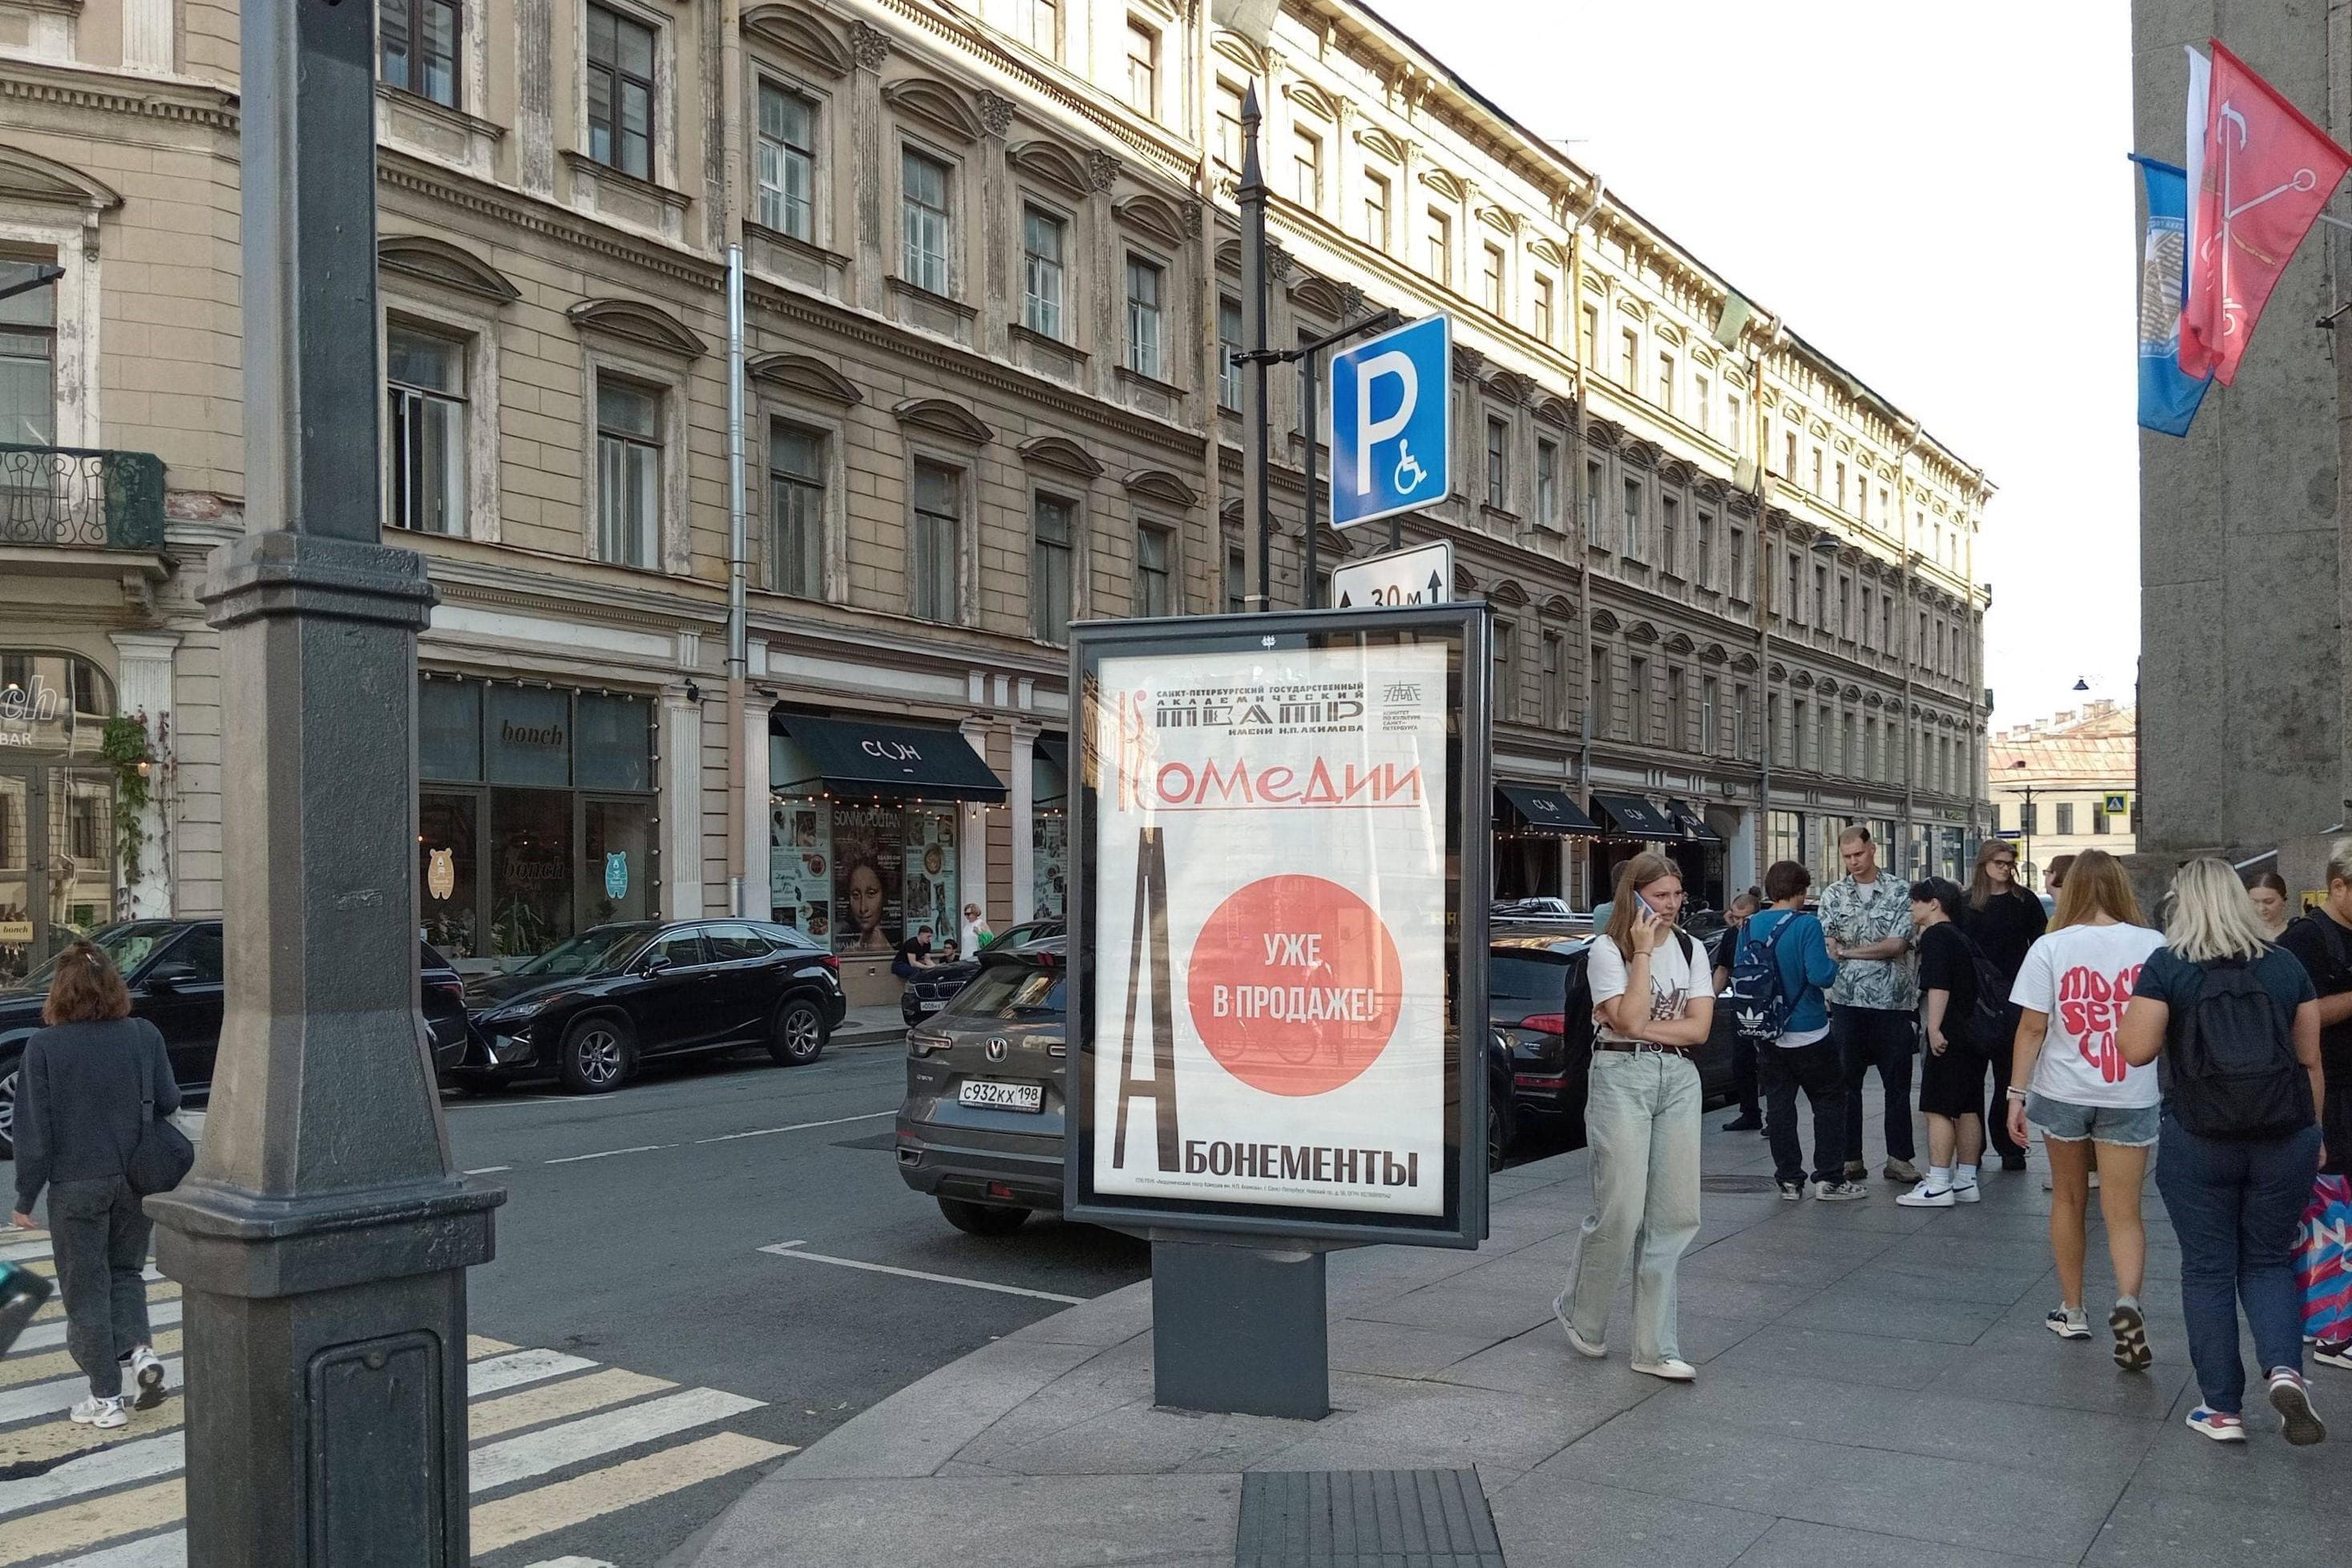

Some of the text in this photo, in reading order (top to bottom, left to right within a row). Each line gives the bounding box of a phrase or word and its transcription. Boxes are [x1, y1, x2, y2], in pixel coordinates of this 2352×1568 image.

[1357, 350, 1418, 496] P
[1372, 584, 1400, 607] 30
[1156, 681, 1364, 698] САНКТ-ПЕТЕРБУРГСКИЙ ГОСУДАРСТВЕННЫЙ
[1157, 690, 1364, 706] АКАДЕМИЧЕСКИЙ
[1156, 701, 1364, 727] ТЕАТР
[502, 720, 562, 746] bonch
[1228, 727, 1273, 736] ИМЕНИ
[1300, 725, 1364, 733] АКИМОВА
[834, 810, 901, 828] SONMOPOLITAN
[3, 925, 28, 933] bonch
[1263, 933, 1322, 967] УЖЕ
[1213, 984, 1374, 1023] В ПРОДАЖЕ!
